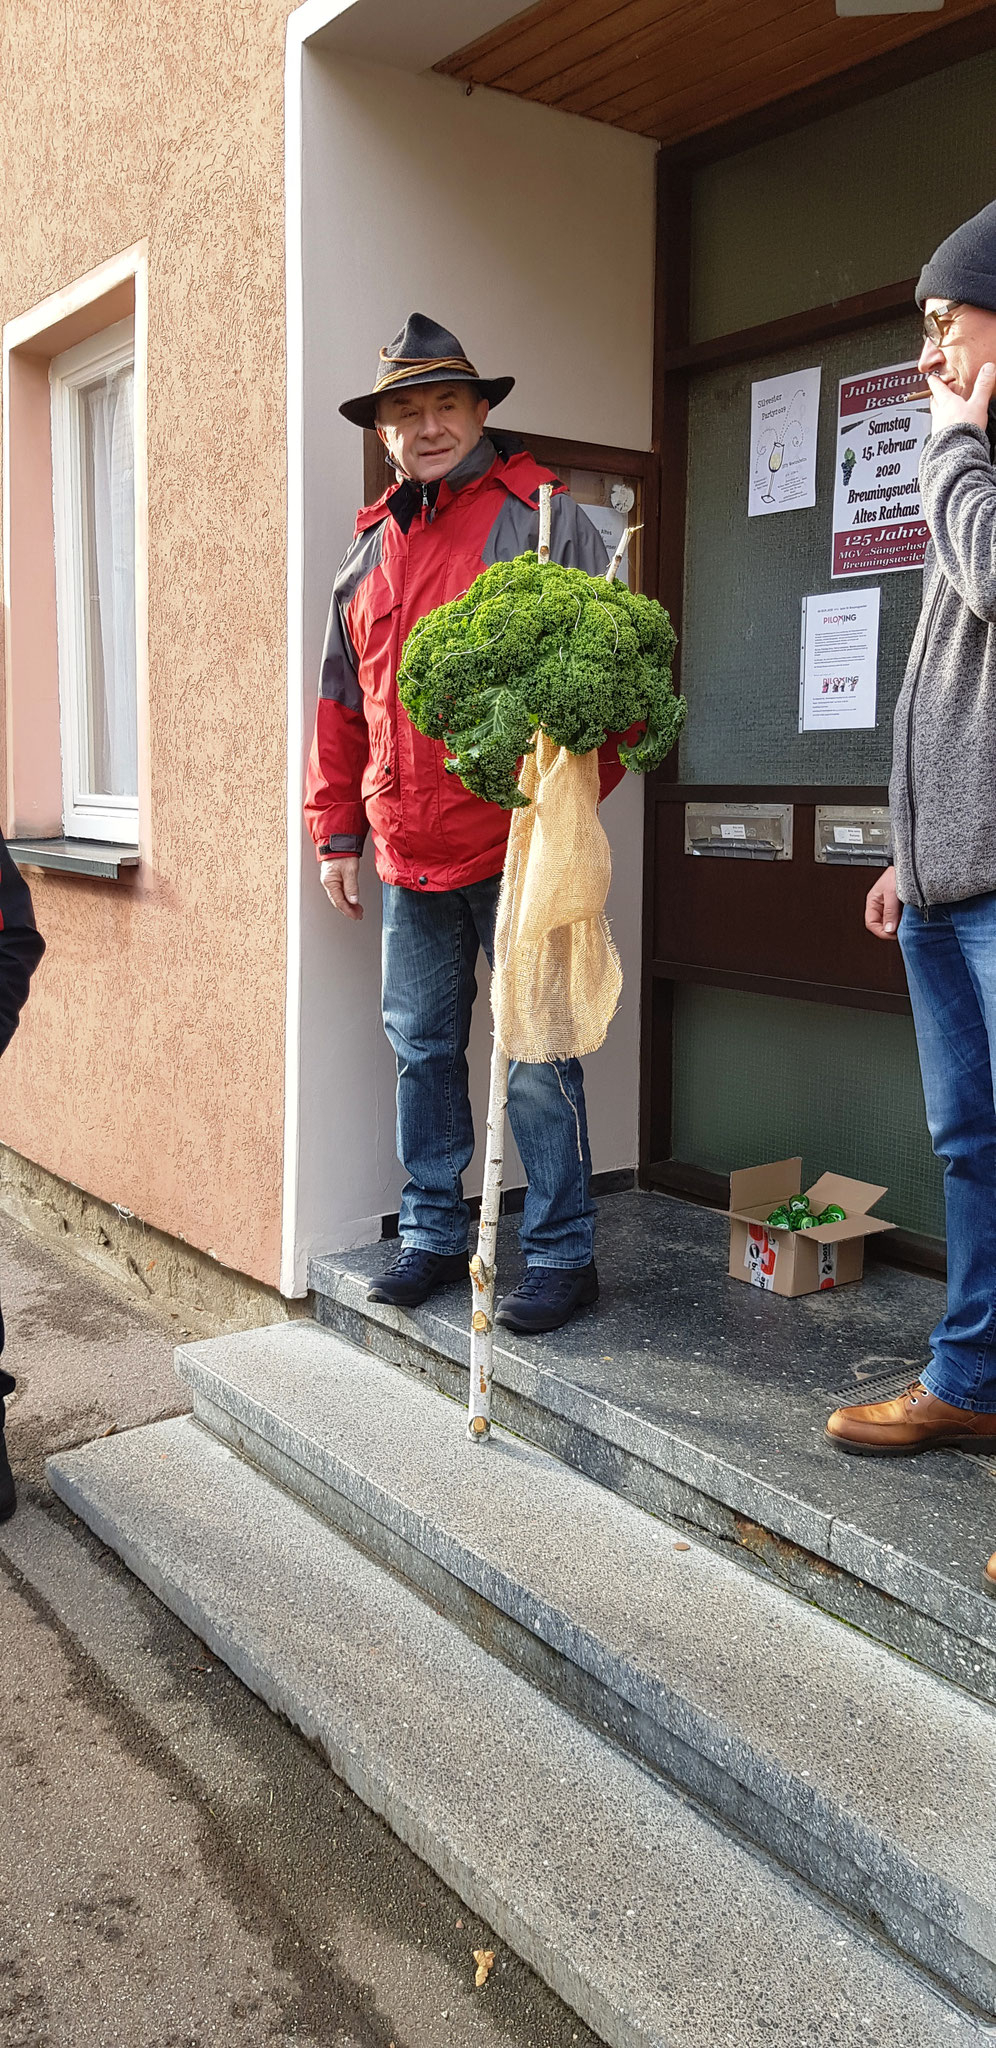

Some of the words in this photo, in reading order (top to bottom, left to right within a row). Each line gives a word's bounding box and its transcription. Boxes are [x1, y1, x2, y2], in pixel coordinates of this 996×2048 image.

[868, 417, 911, 436] Samstag
[861, 446, 875, 461] 15.
[877, 438, 917, 456] Februar
[875, 463, 901, 478] 2020
[852, 508, 877, 525] Altes
[878, 502, 920, 521] Rathaus
[844, 534, 872, 546] 125
[875, 526, 927, 542] Jahre
[838, 549, 863, 559] MGV
[823, 614, 857, 625] PILOXING
